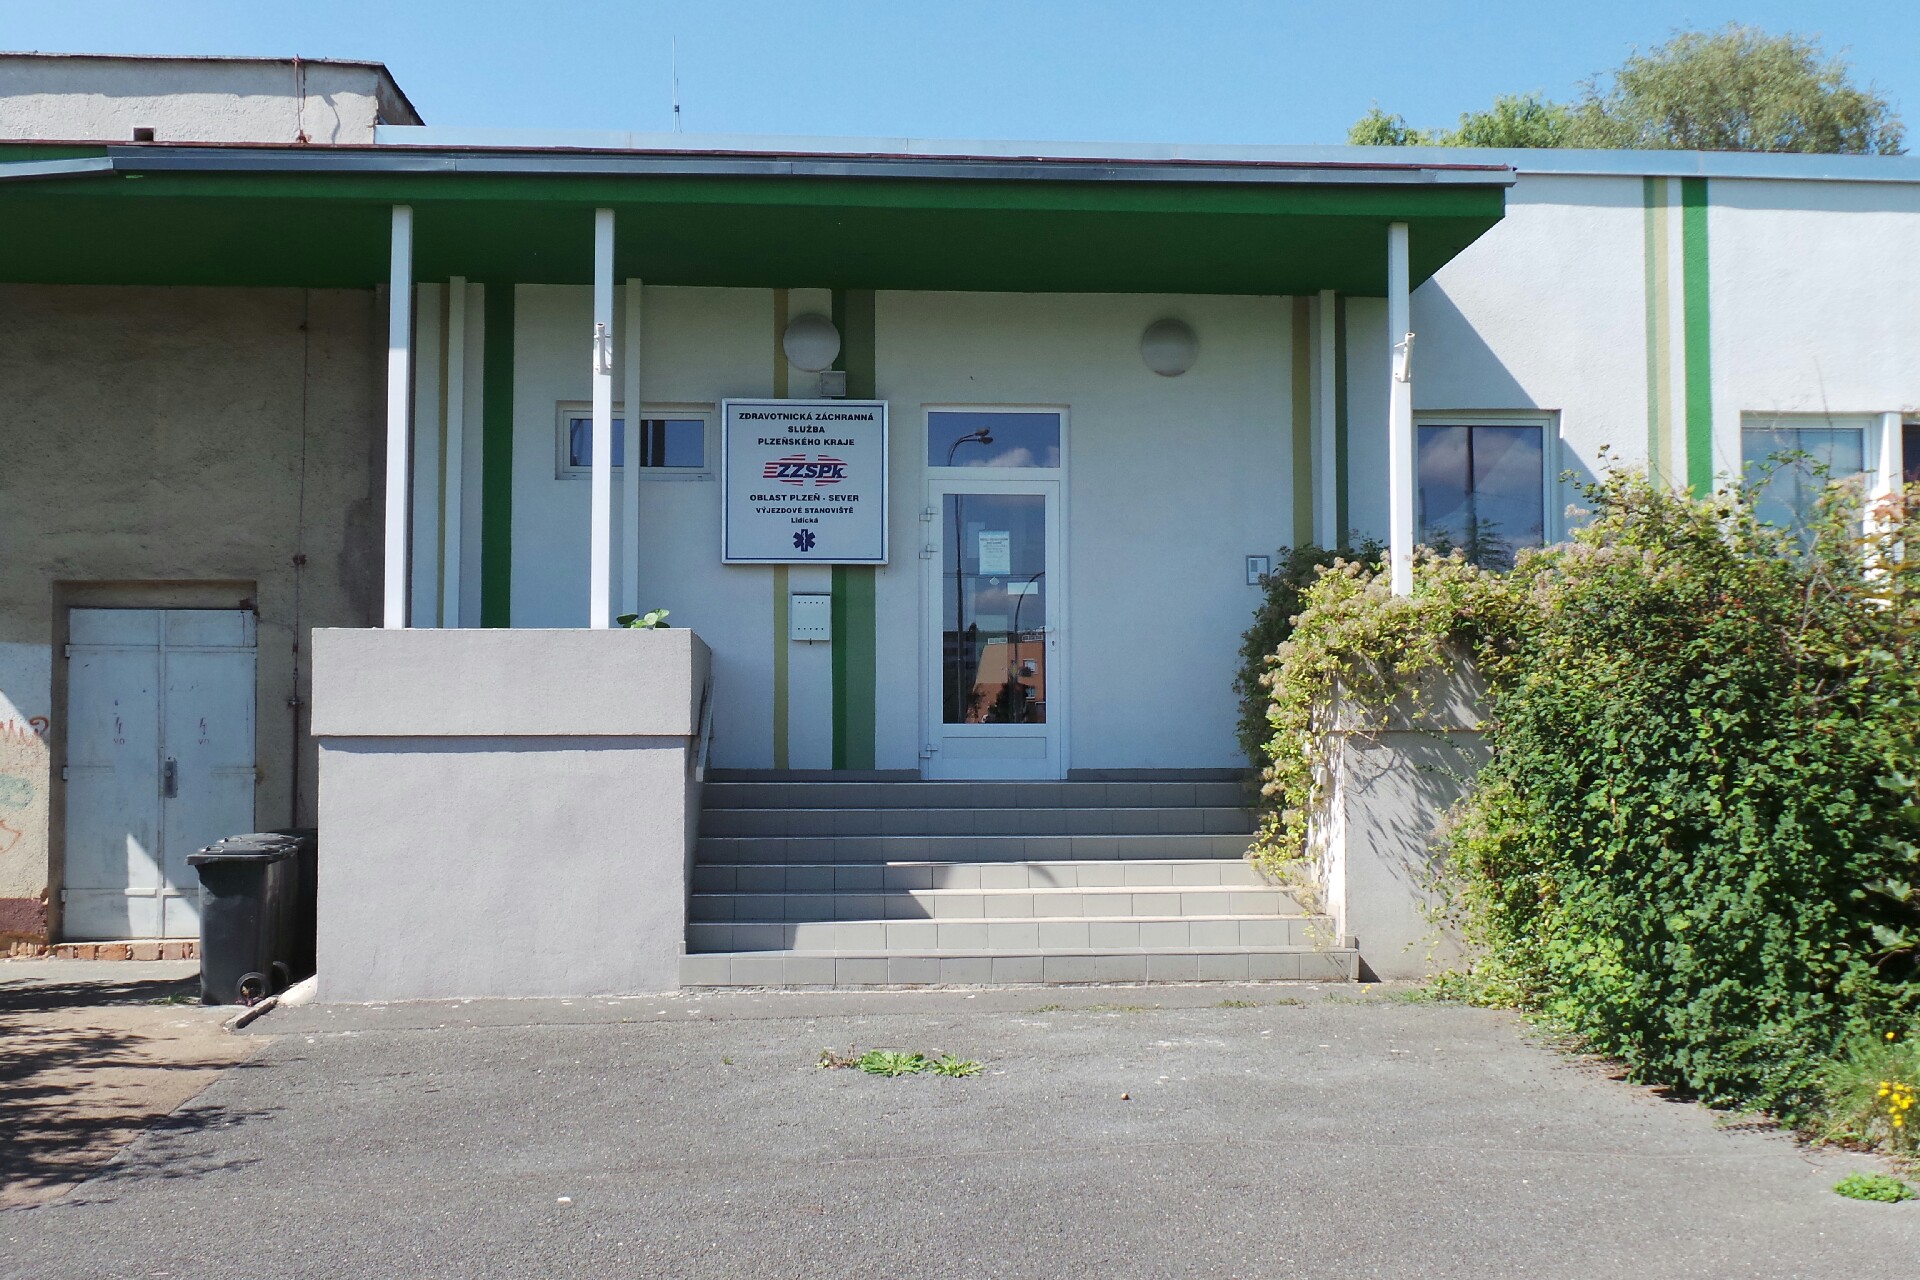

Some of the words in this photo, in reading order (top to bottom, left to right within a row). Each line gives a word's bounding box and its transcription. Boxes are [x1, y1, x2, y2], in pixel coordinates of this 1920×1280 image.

[739, 412, 813, 420] ZDRAVOTNICKÁ
[788, 425, 825, 433] SLUŽBA
[758, 437, 820, 445] PLZEŇSKÉHO
[790, 493, 820, 501] PLZEŇ
[756, 506, 802, 514] VÝJEZDOVÉ
